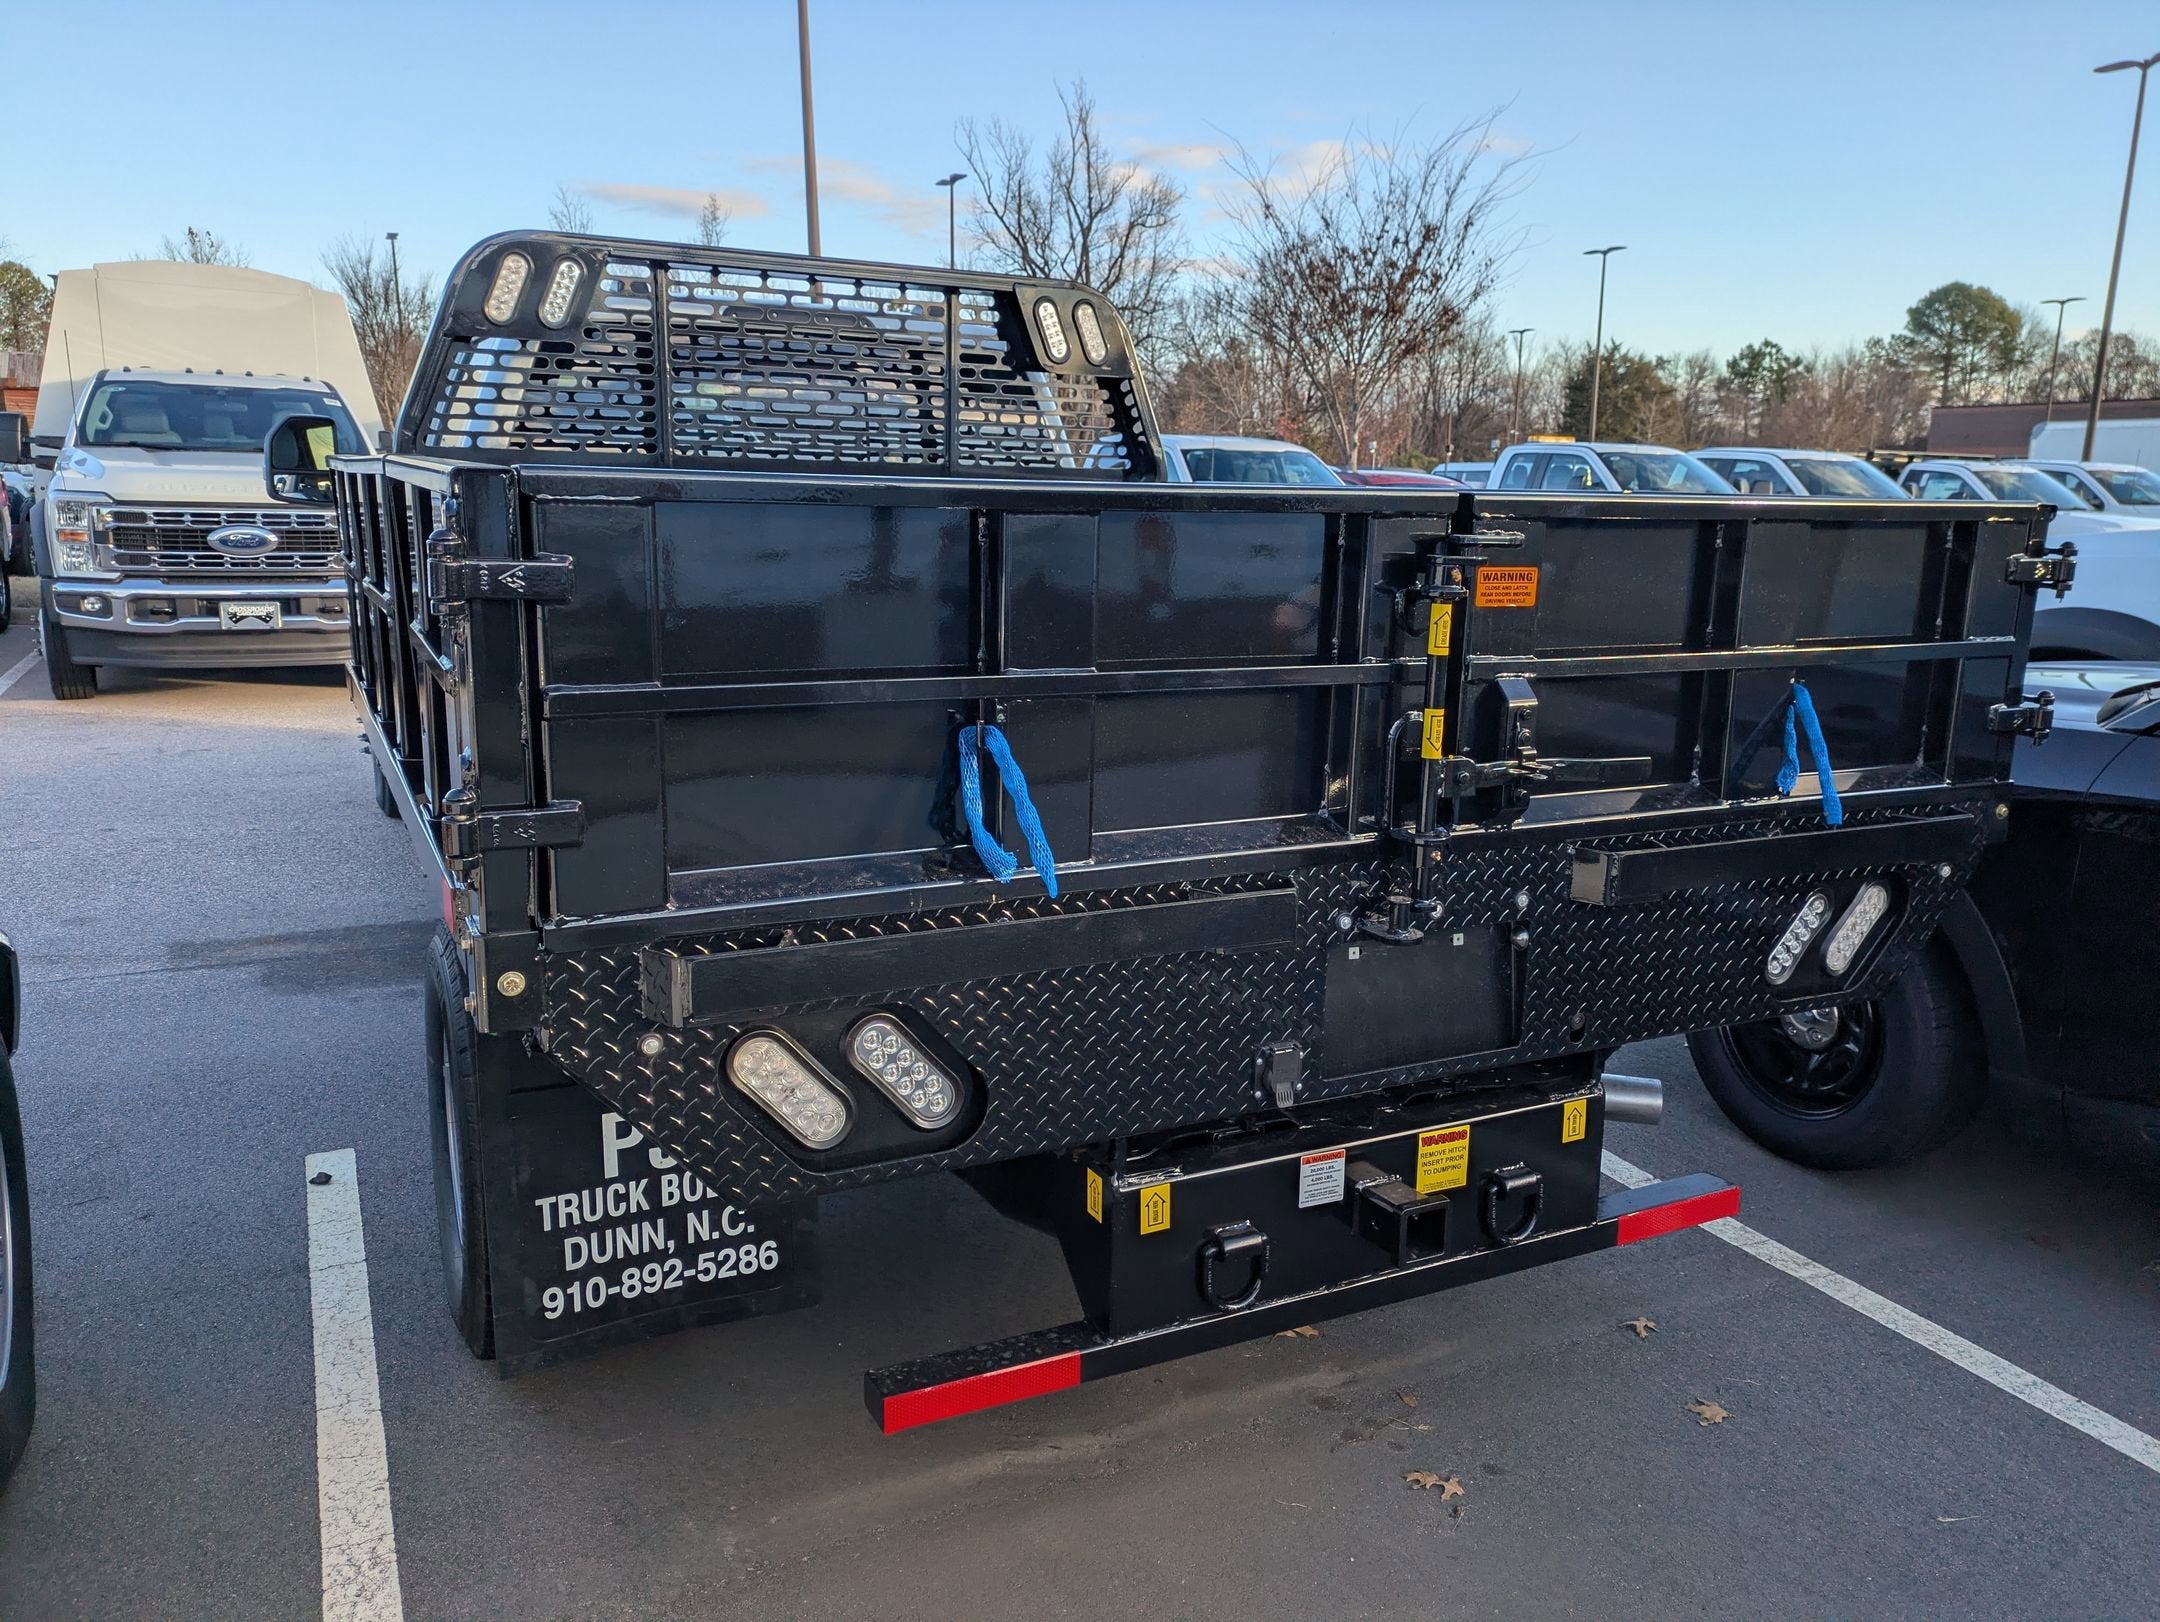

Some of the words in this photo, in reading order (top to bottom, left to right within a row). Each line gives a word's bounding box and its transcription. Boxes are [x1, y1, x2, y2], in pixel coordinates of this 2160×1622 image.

[228, 534, 259, 546] Ford
[1482, 572, 1533, 582] WARNING
[1421, 1129, 1468, 1147] WARNING
[1311, 1151, 1342, 1164] WARNING
[1420, 1149, 1447, 1159] REMOVE
[1448, 1145, 1466, 1154] HITCH
[1421, 1158, 1444, 1168] INSERT
[1446, 1154, 1464, 1163] PRIOR
[1433, 1163, 1462, 1175] DUMPING
[535, 1179, 650, 1232] TRUCK
[564, 1218, 675, 1272] DUNN,
[687, 1205, 755, 1245] N.C.
[542, 1240, 779, 1320] 910-892-5286
